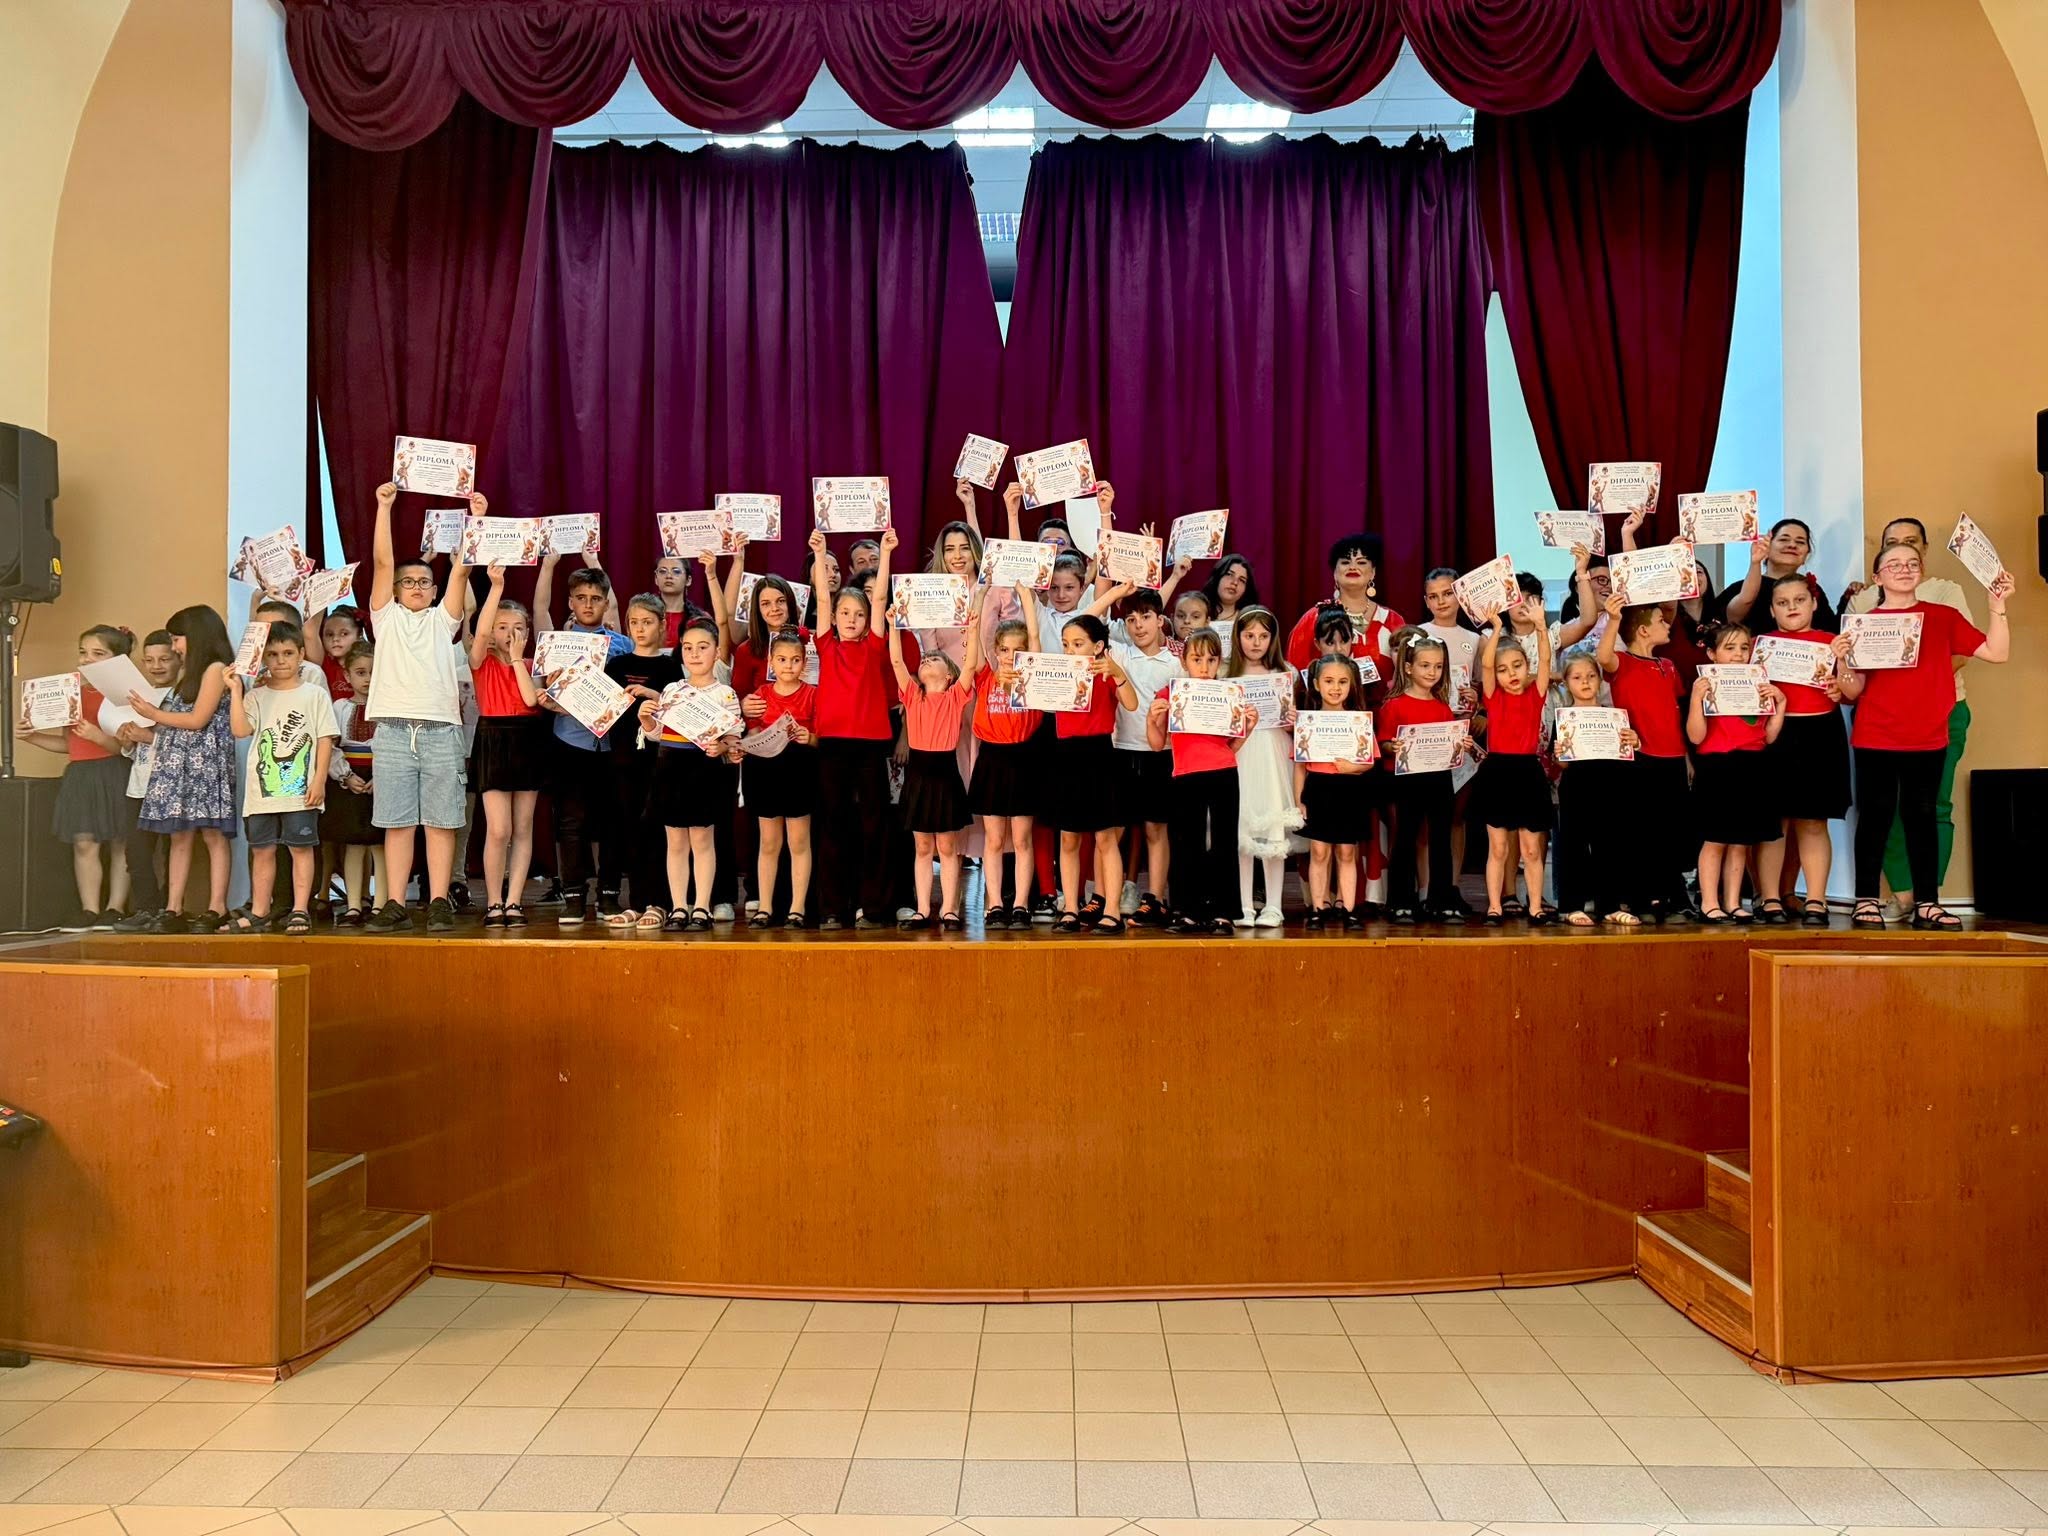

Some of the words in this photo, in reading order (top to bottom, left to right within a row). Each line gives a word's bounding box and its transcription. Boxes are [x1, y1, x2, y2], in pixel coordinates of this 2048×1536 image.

[971, 449, 992, 460] DIPLOMĂ
[416, 455, 455, 466] DIPLOMĂ
[1038, 460, 1073, 474] DIPLOMĂ
[1610, 477, 1645, 485] DIPLOMĂ
[835, 493, 871, 501] DIPLOMĂ
[1701, 506, 1739, 515] DIPLOMĂ
[680, 523, 717, 532] DIPLOMĂ
[257, 545, 285, 561] DIPLOMĂ
[1113, 547, 1145, 558] DIPLOMĂ
[1002, 555, 1037, 564] DIPLOMĂ
[1633, 561, 1674, 574] DIPLOMĂ
[1469, 577, 1498, 595] DIPLOMĂ
[1863, 629, 1901, 638] DIPLOMĂ
[554, 643, 589, 652] DIPLOMĂ
[1775, 650, 1814, 661] DIPLOMĂ
[1035, 670, 1073, 679] DIPLOMĂ
[1720, 678, 1753, 686] DIPLOMĂ
[36, 689, 65, 700] DIPLOMĂ
[582, 678, 610, 703] DIPLOMĂ
[1191, 695, 1228, 704] DIPLOMĂ
[686, 702, 716, 722] DIPLOMĂ
[1579, 722, 1615, 730] DIPLOMĂ
[1416, 736, 1451, 745] DIPLOMĂ
